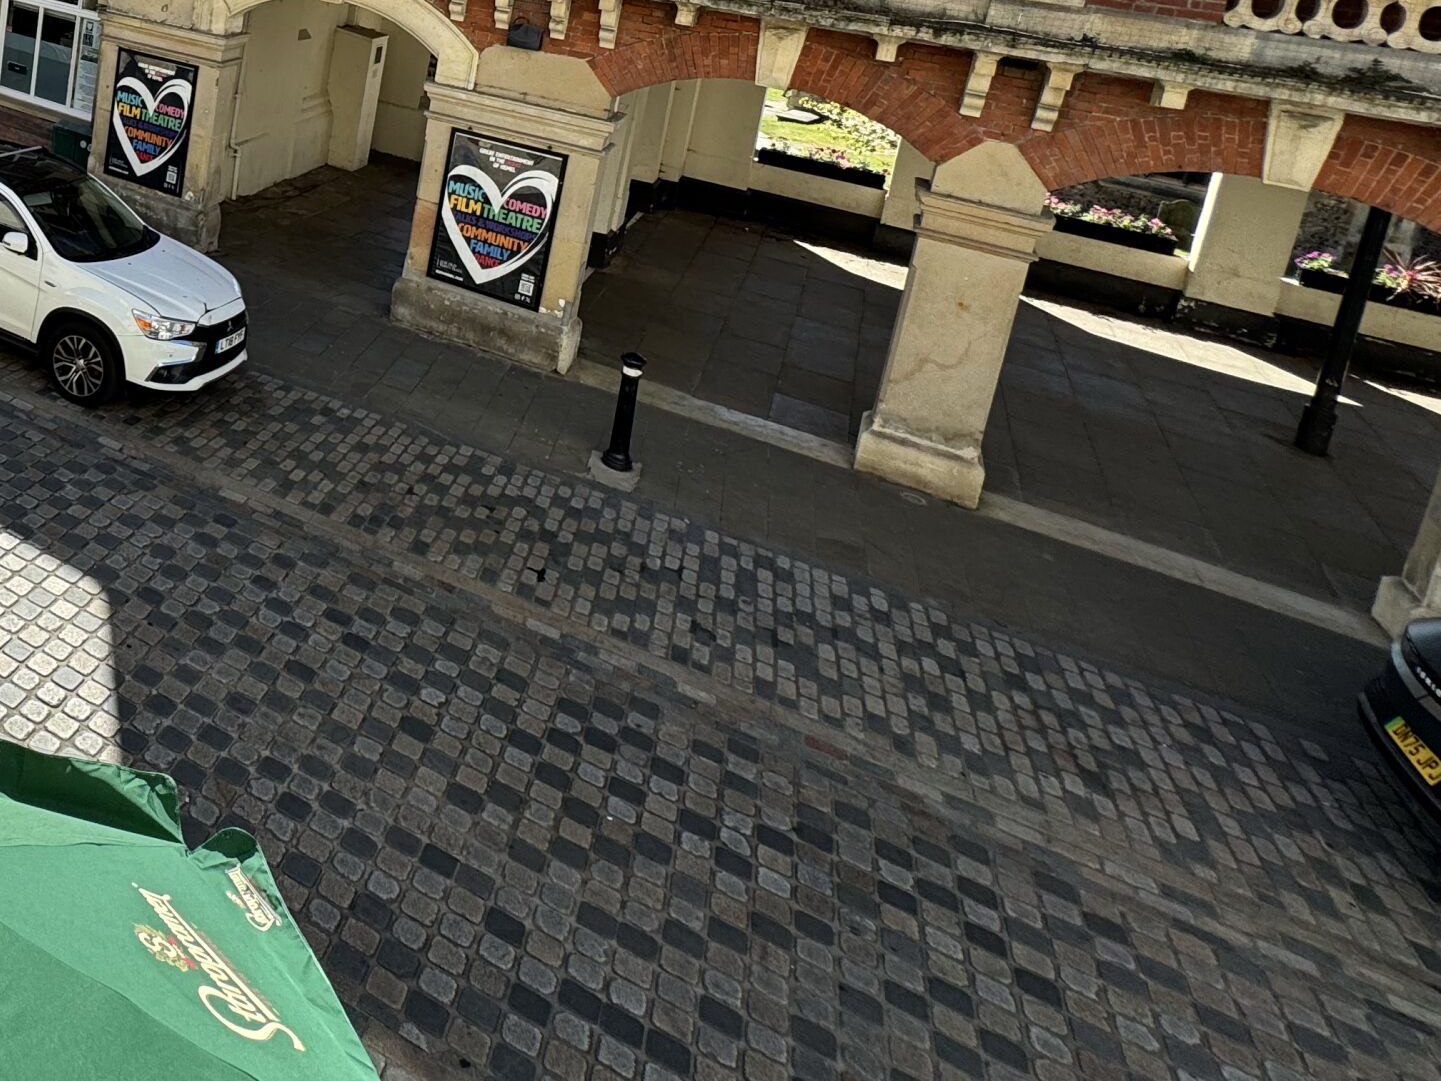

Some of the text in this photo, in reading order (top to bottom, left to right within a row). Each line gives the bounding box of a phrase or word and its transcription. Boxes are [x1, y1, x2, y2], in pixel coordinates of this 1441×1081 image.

[117, 91, 145, 107] MUSIC
[118, 103, 141, 120] FILM
[141, 108, 182, 132] THEATRE
[155, 103, 186, 119] COMEDY
[124, 126, 174, 148] COMMUNITY
[132, 140, 161, 156] FAMILY
[449, 180, 487, 202] MUSIC
[450, 195, 542, 233] FILM THEATRE
[504, 197, 548, 219] COMEDY
[458, 222, 529, 252] COMMUNITY
[470, 239, 511, 261] FAMILY
[131, 881, 306, 1052] Staropramen
